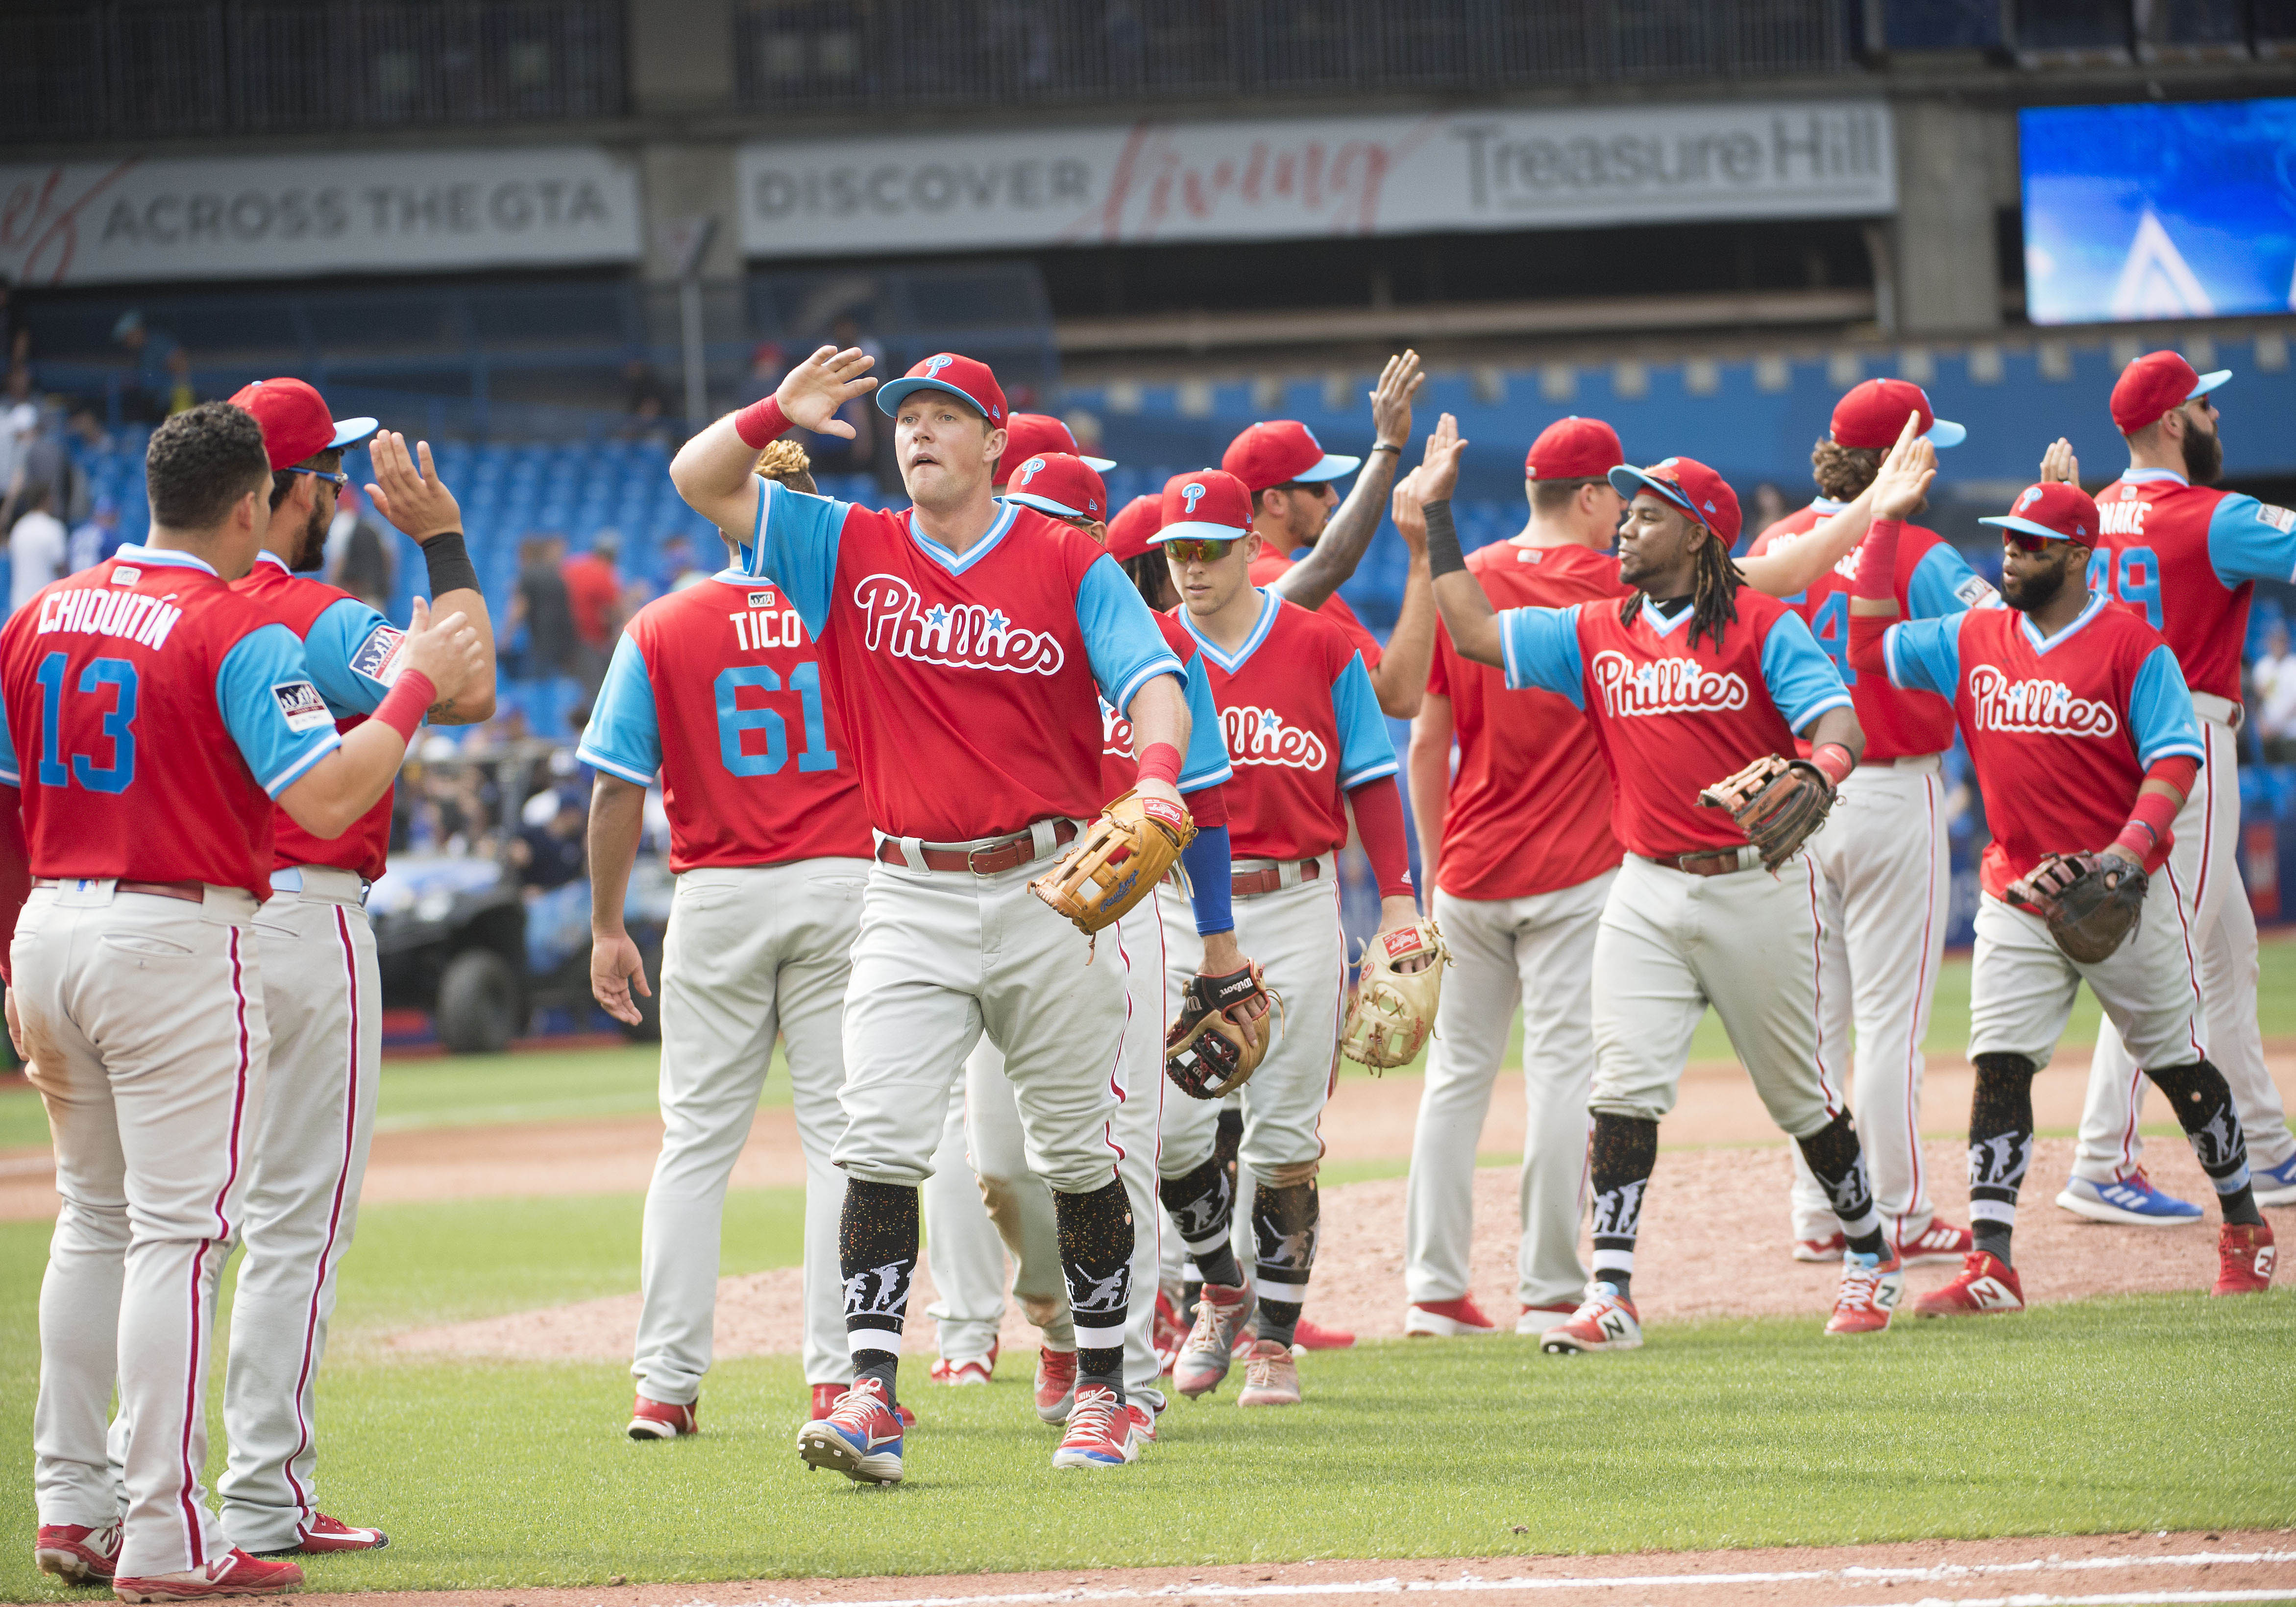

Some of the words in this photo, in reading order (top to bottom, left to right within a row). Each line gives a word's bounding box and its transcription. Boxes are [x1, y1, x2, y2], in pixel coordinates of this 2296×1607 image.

[101, 192, 349, 244] ACROSS
[357, 183, 480, 236] THE
[491, 176, 611, 233] GTA
[751, 158, 1093, 220] DISCOVER
[1073, 119, 1433, 242] living
[2097, 501, 2152, 535] NAKE
[37, 588, 182, 651] CHIQUITÍN
[854, 573, 1064, 676] Phillies
[2086, 546, 2164, 632] 49
[729, 609, 801, 651] TICO
[1592, 650, 1749, 717] Phillies
[1969, 664, 2118, 738] Phillies
[36, 651, 139, 794] 13
[714, 662, 838, 777] 61
[1223, 977, 1253, 996] Wilson
